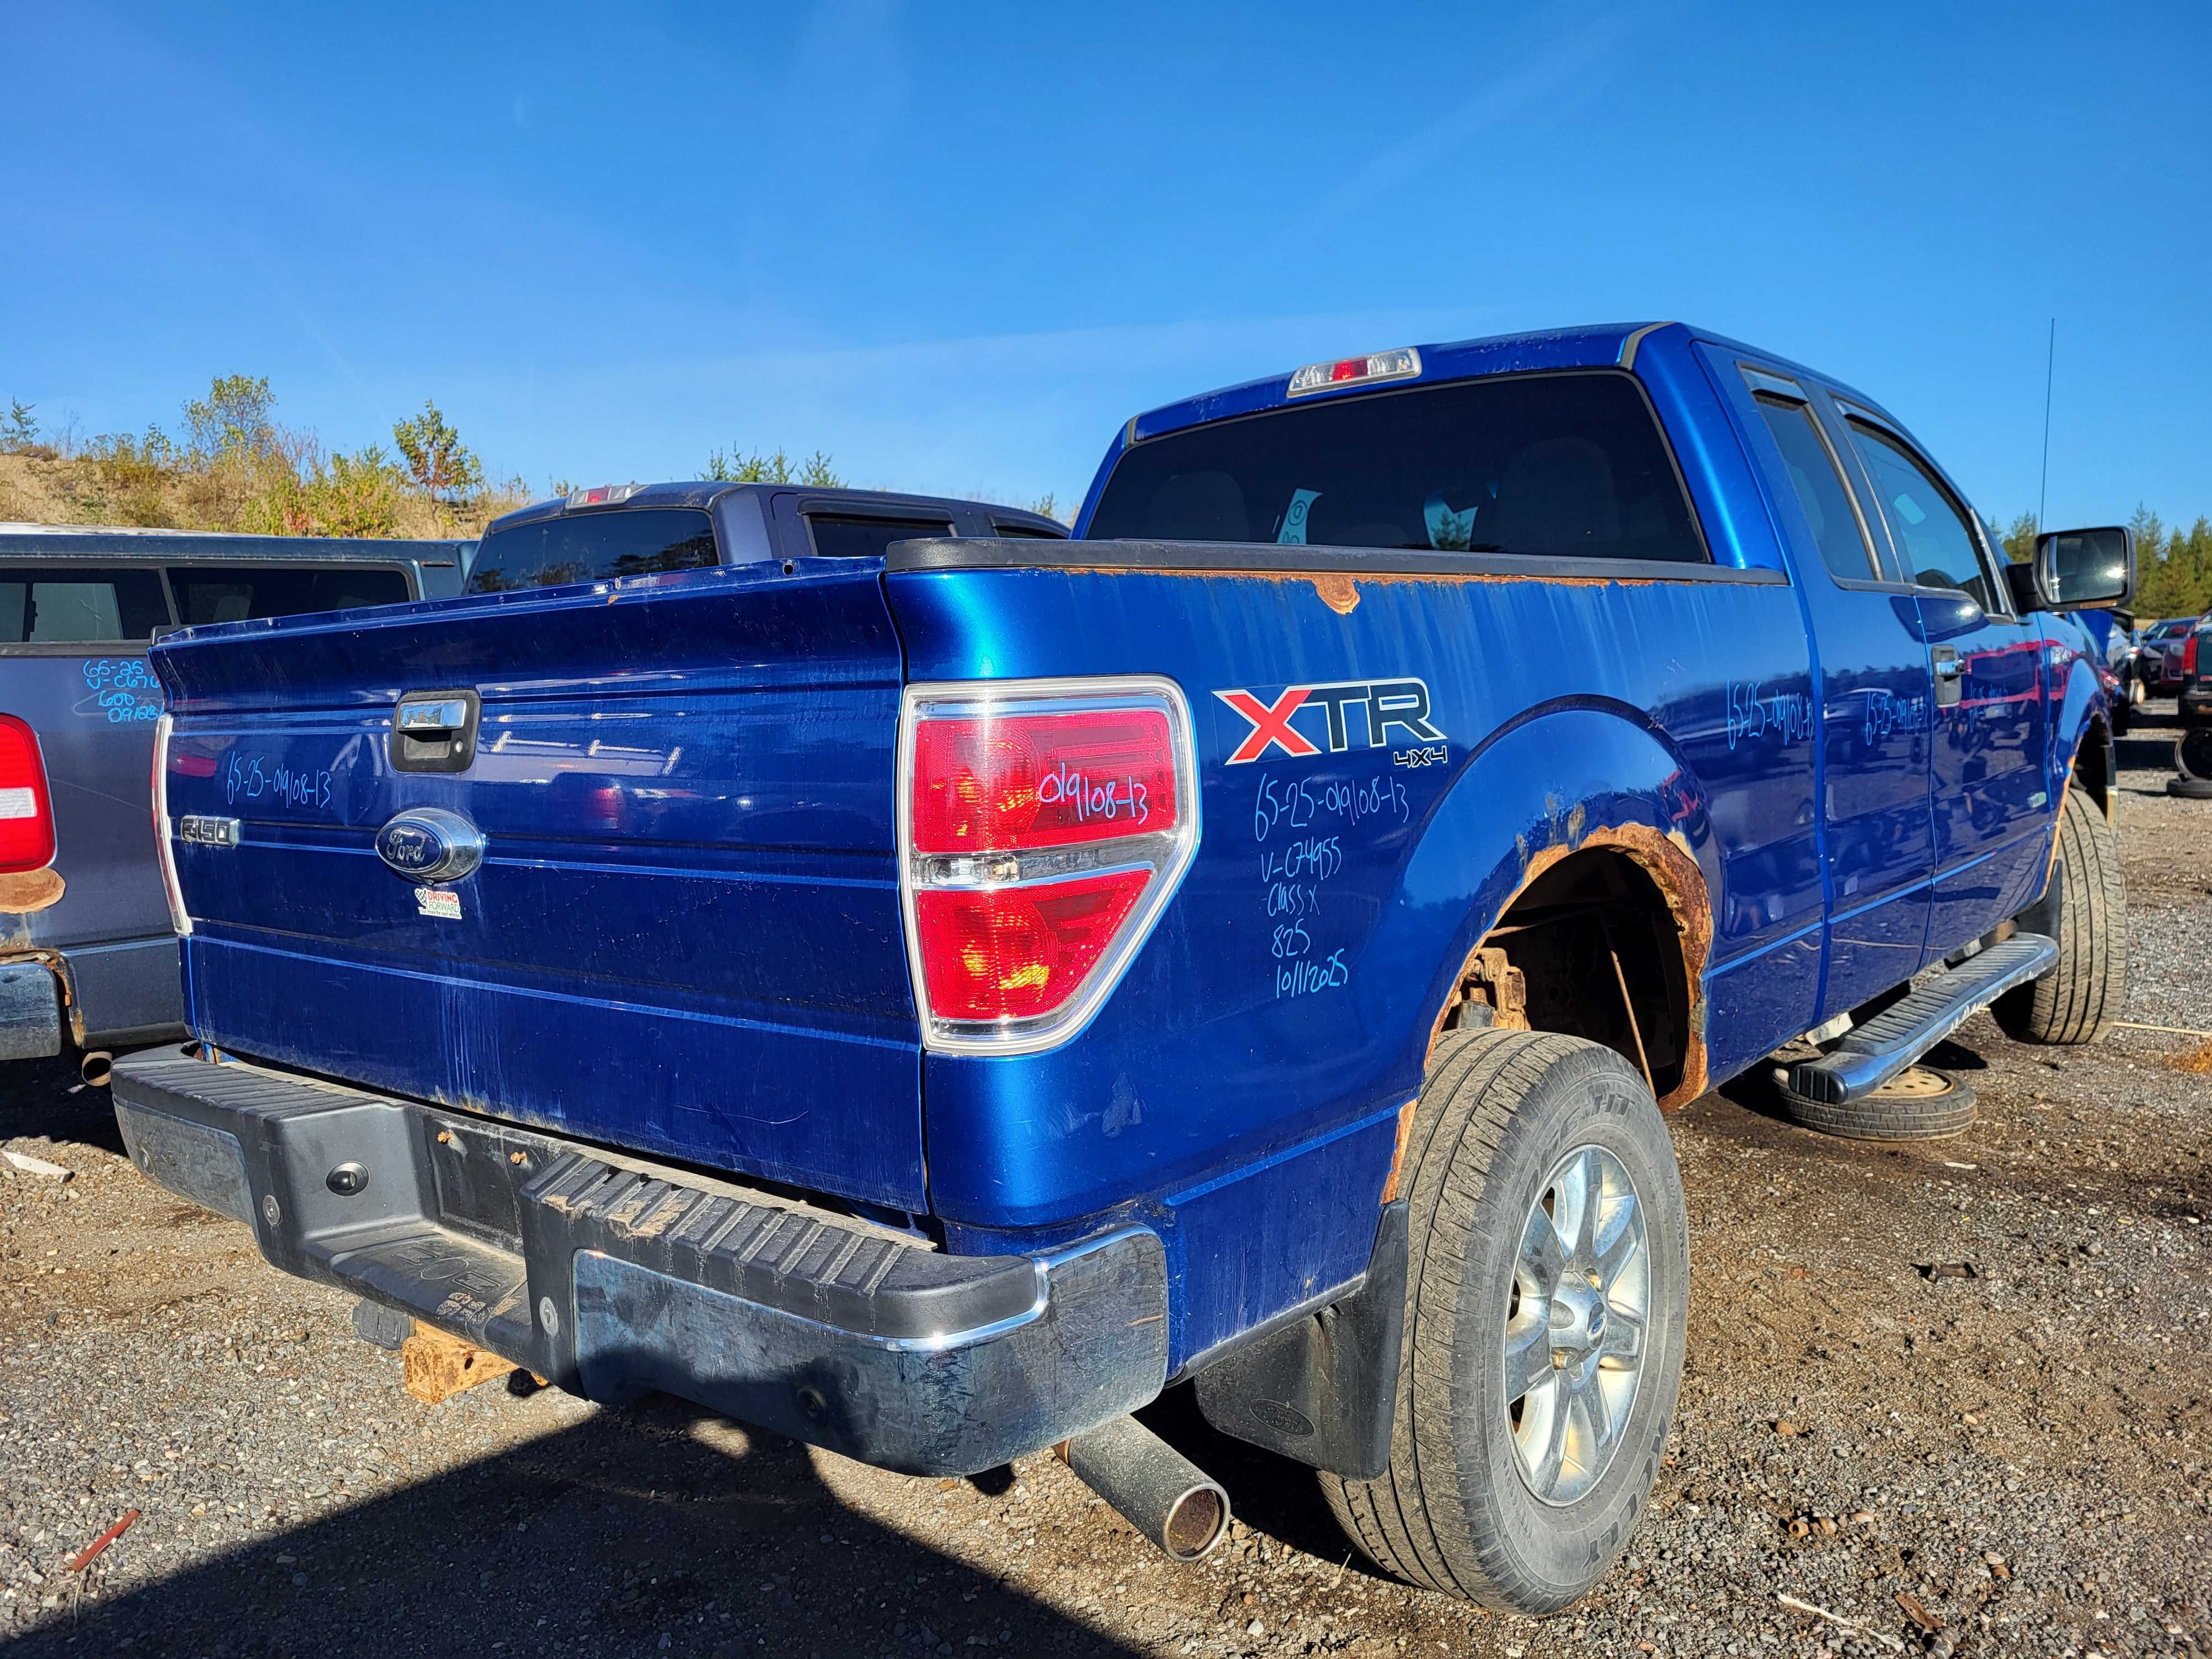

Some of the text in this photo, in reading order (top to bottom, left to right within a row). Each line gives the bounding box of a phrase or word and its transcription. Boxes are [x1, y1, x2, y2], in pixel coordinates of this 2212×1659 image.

[1212, 677, 1448, 765] XTR
[227, 751, 331, 808] 65-25-019108-13
[1039, 761, 1149, 826] 019108-13
[1255, 773, 1410, 842] 65-25-019108-13
[385, 828, 426, 863] Ford
[428, 891, 457, 903] DRIVING
[429, 901, 459, 912] FORWARD
[1272, 919, 1310, 958] 825
[1580, 1413, 1667, 1571] KELLY
